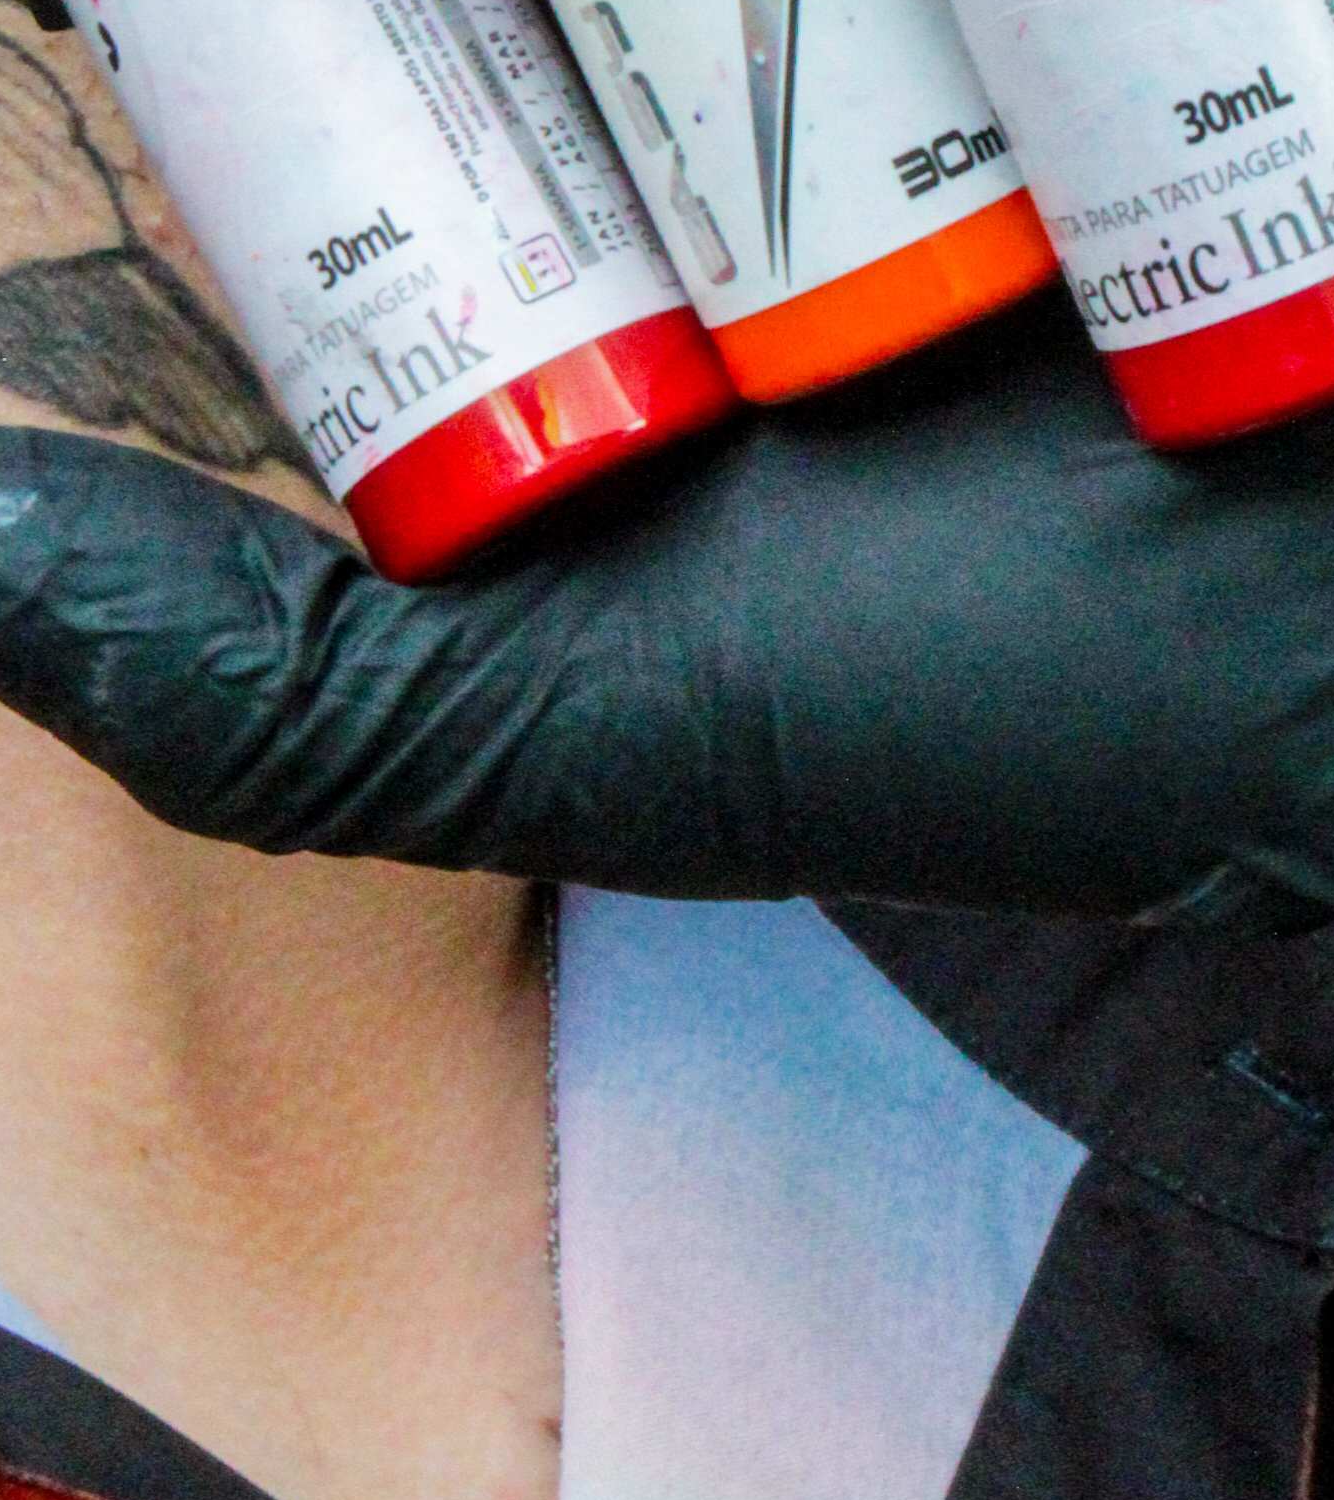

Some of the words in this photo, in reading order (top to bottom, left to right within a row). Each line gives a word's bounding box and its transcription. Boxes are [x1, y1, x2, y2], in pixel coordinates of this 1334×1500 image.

[370, 1, 409, 58] ABERTO
[486, 28, 523, 82] MAR
[397, 55, 431, 99] APÓS
[463, 38, 510, 109] SEMANA
[423, 95, 451, 132] DIAS
[1173, 66, 1293, 145] 30mL
[537, 120, 570, 167] FEV
[551, 113, 587, 166] AGO
[458, 159, 484, 191] POR
[531, 161, 579, 232] SEMANA
[1085, 194, 1152, 232] PARA
[1151, 128, 1314, 211] TATUAGEM
[307, 207, 413, 290] 30mL
[586, 207, 619, 255] JAN
[299, 263, 440, 350] TATUAGEM
[358, 298, 489, 412] Ink
